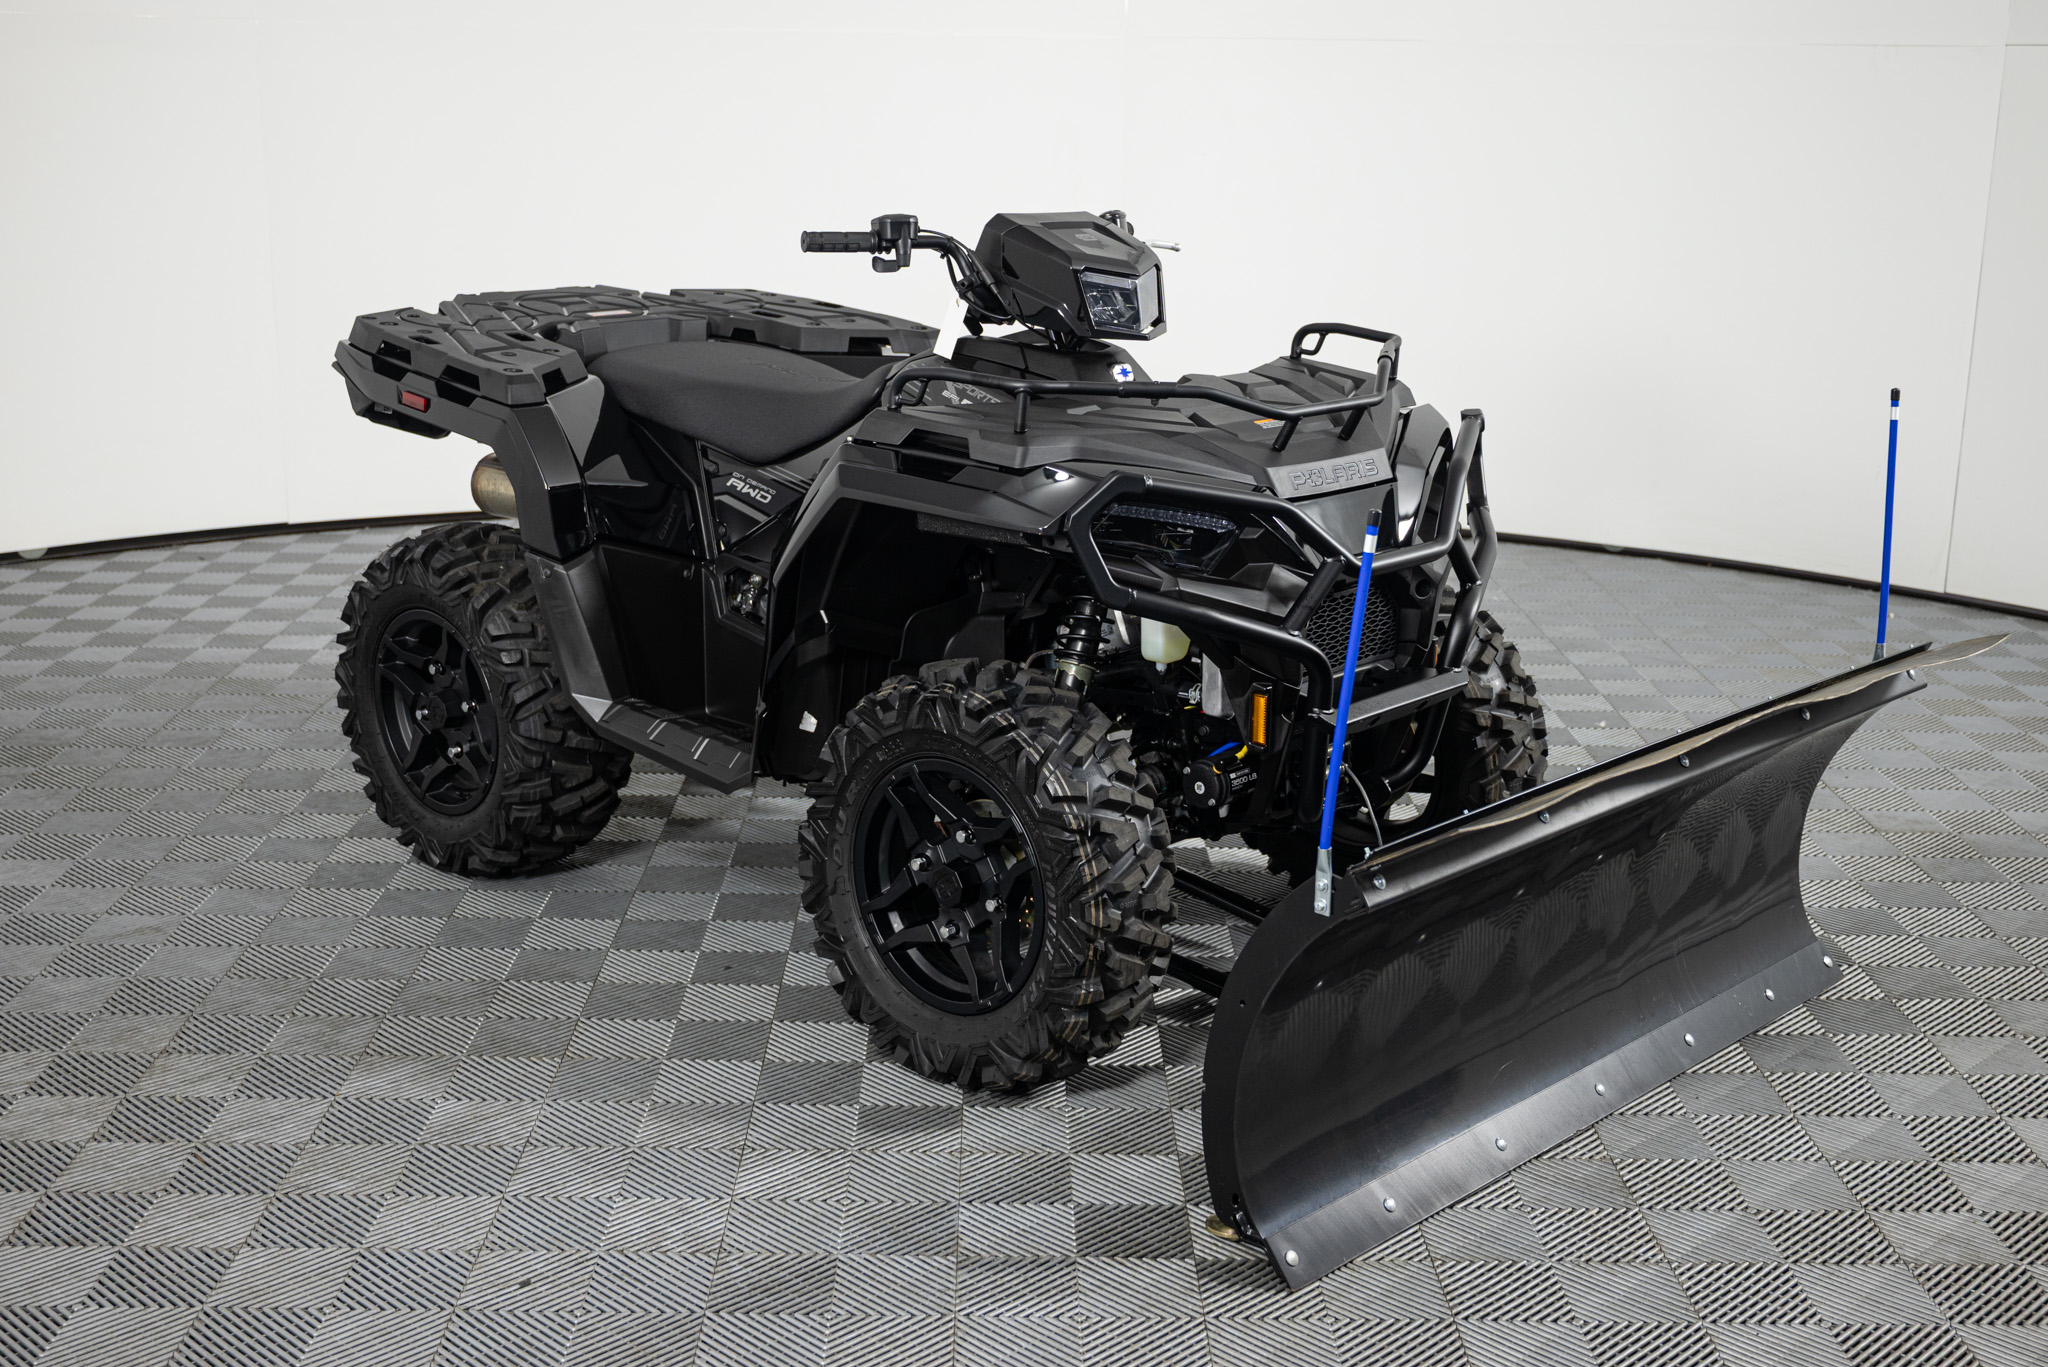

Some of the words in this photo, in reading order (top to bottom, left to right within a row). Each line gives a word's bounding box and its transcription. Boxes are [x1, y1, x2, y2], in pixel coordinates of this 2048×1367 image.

[732, 471, 745, 480] ON
[746, 477, 776, 495] DEMAND
[1289, 458, 1379, 491] POLARIS
[726, 477, 772, 504] AWD
